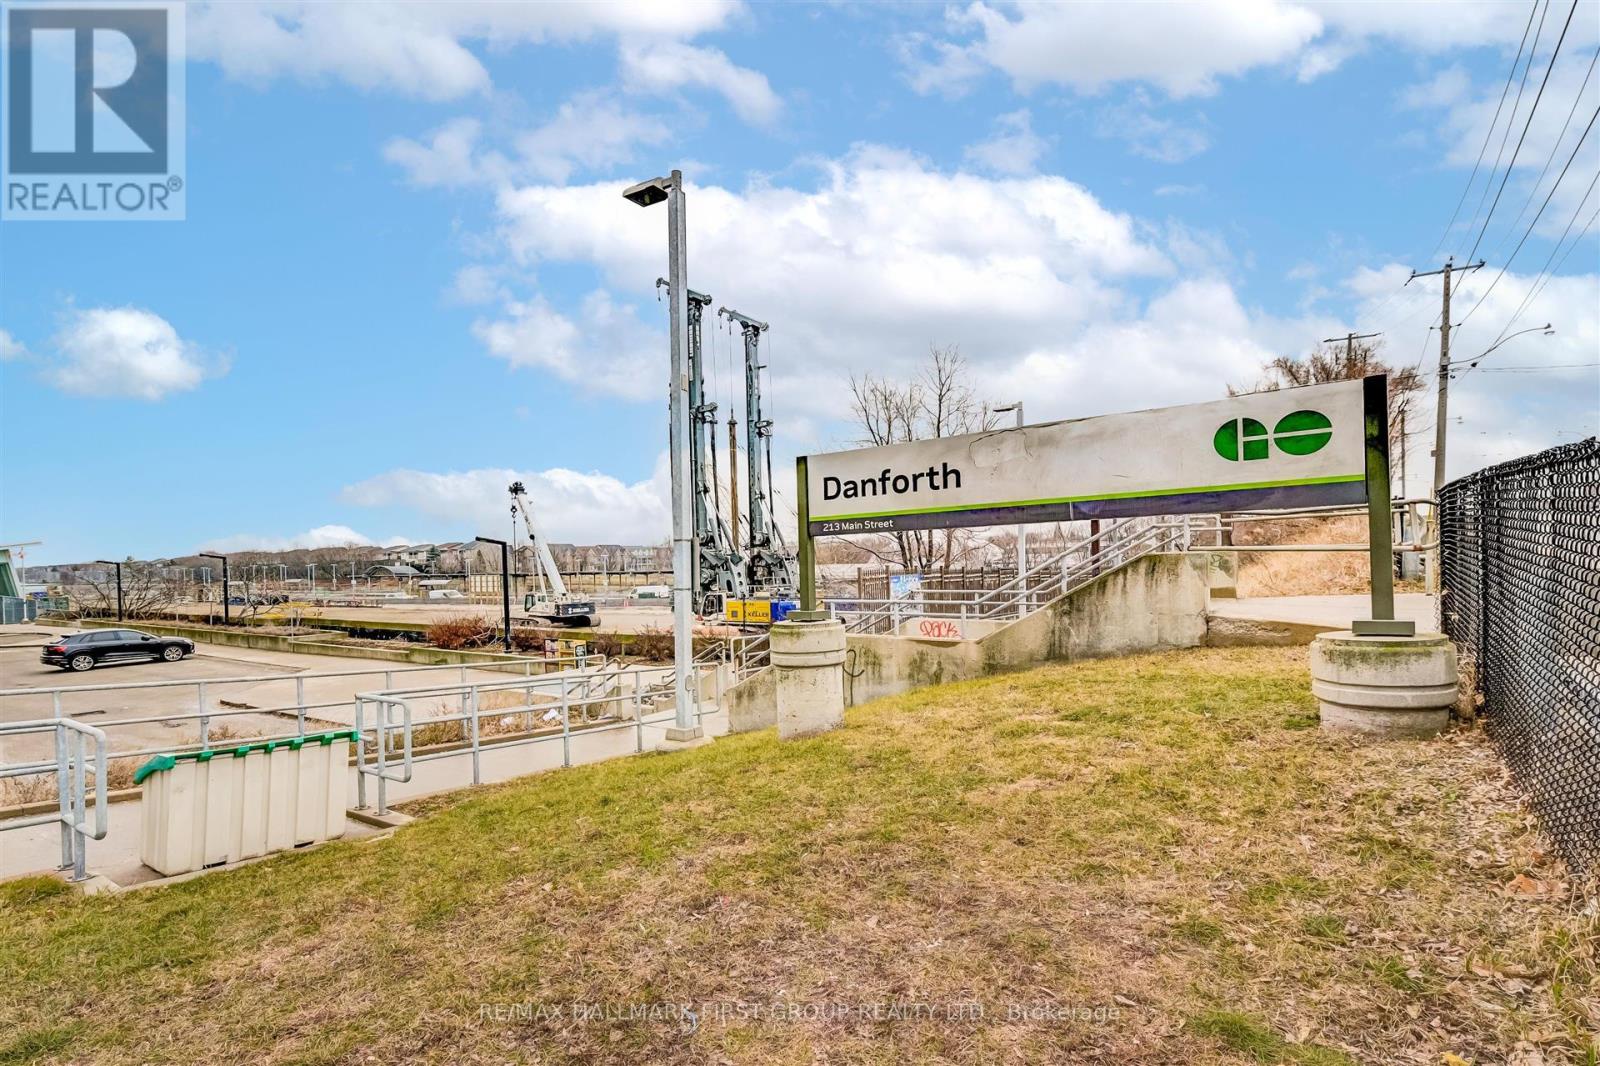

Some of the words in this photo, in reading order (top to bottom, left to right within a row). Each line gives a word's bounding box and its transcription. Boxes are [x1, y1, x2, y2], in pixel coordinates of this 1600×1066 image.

[823, 462, 962, 500] Danforth
[823, 523, 840, 532] 213
[841, 521, 863, 530] Main
[864, 519, 894, 530] Street
